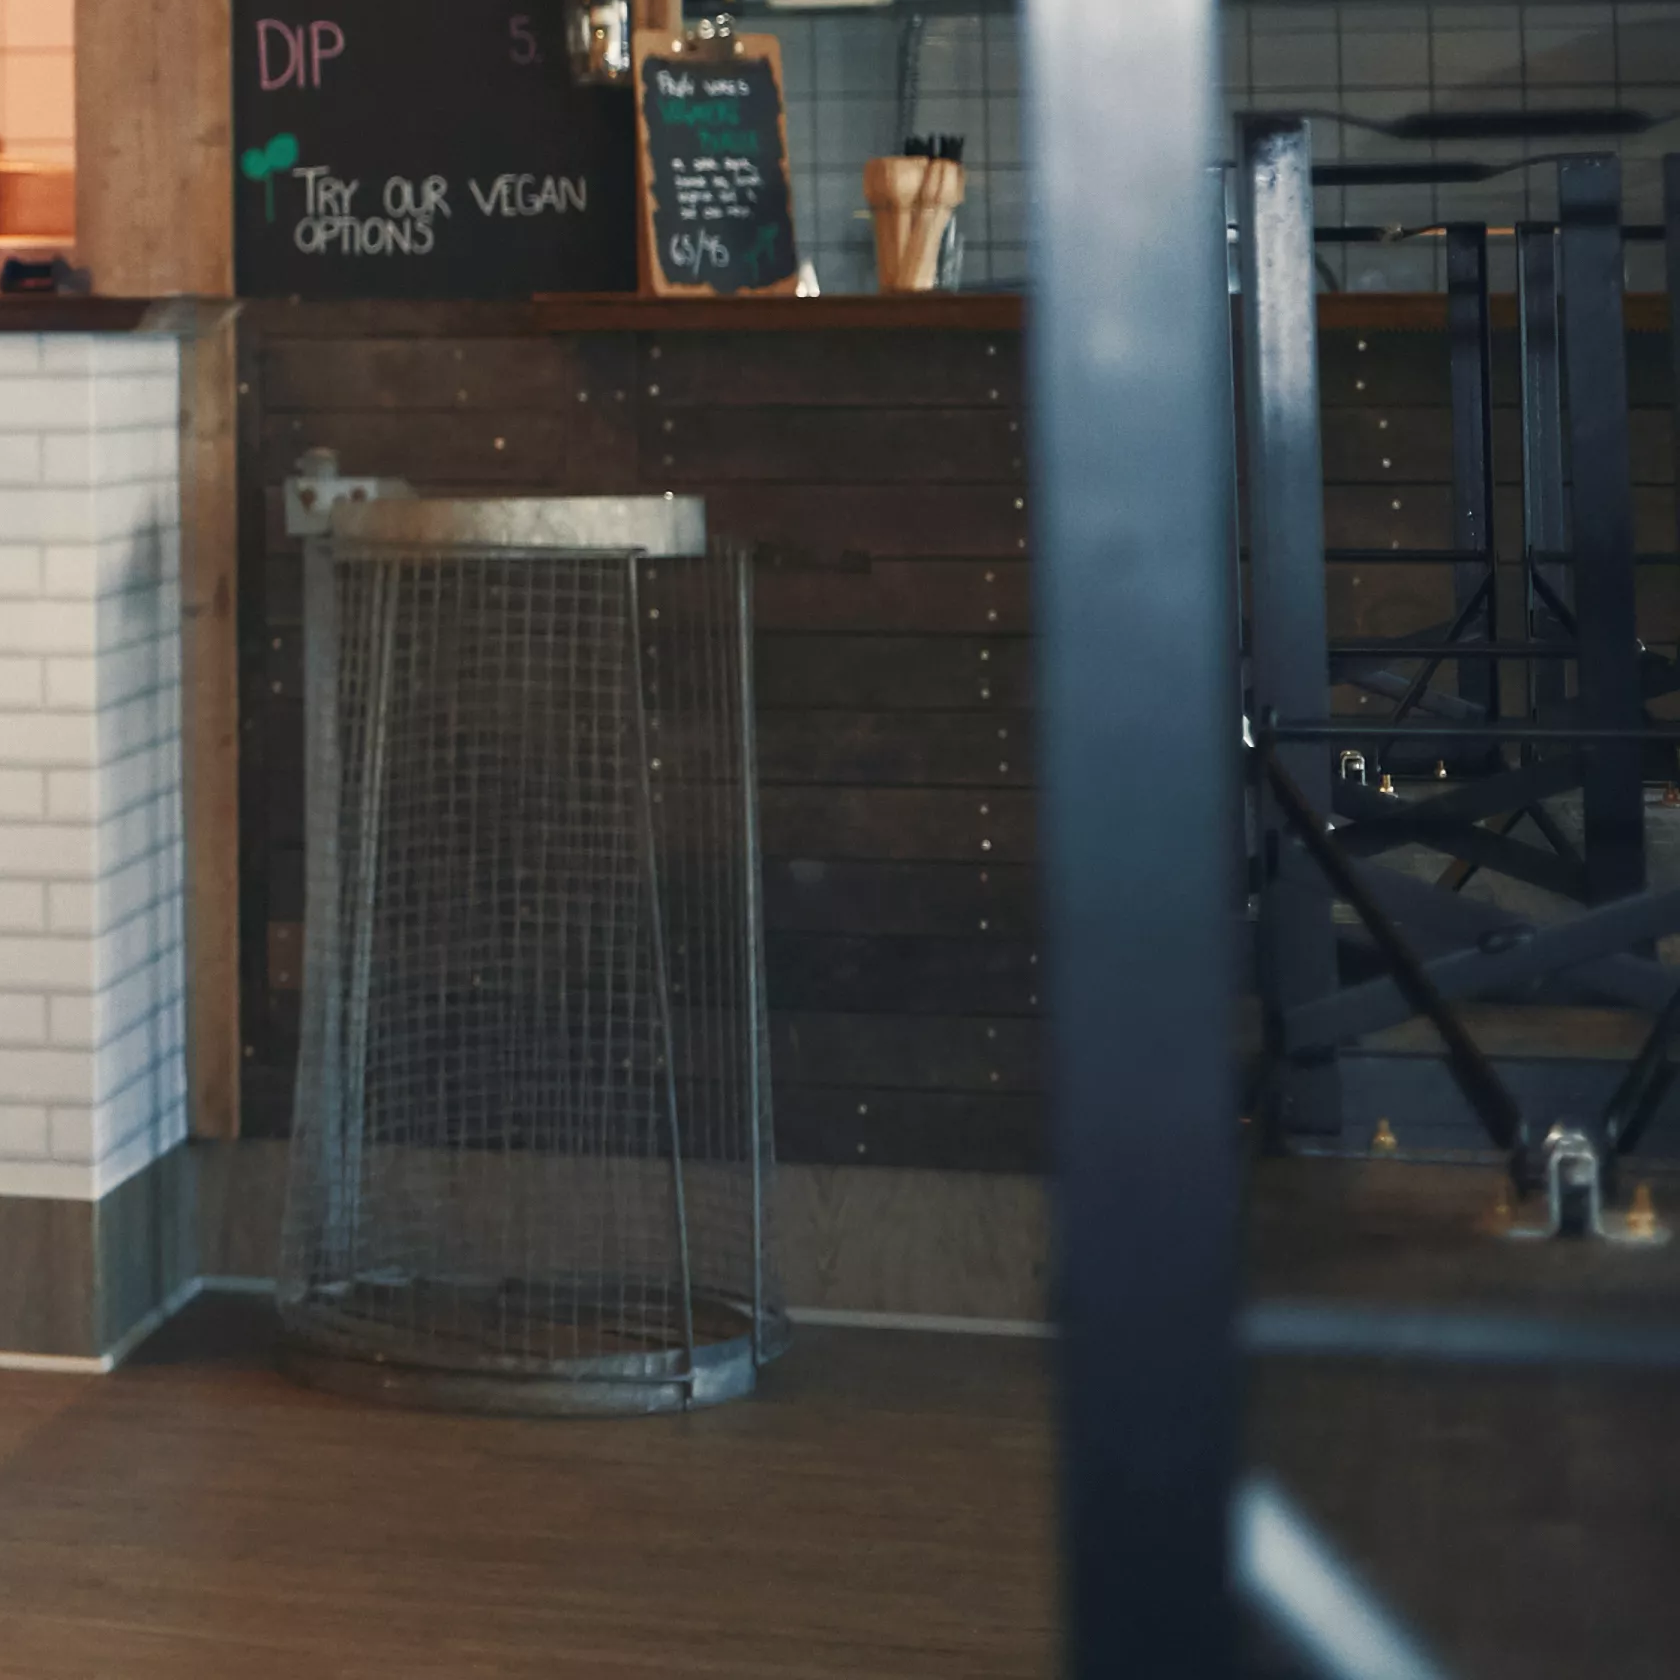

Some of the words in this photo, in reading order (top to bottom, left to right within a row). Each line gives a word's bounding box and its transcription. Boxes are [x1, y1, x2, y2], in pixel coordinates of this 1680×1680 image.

[256, 17, 346, 91] DIP
[293, 165, 360, 217] TRY
[383, 174, 451, 219] OUR
[468, 172, 588, 218] VEGAN
[293, 216, 435, 256] OPTIONS
